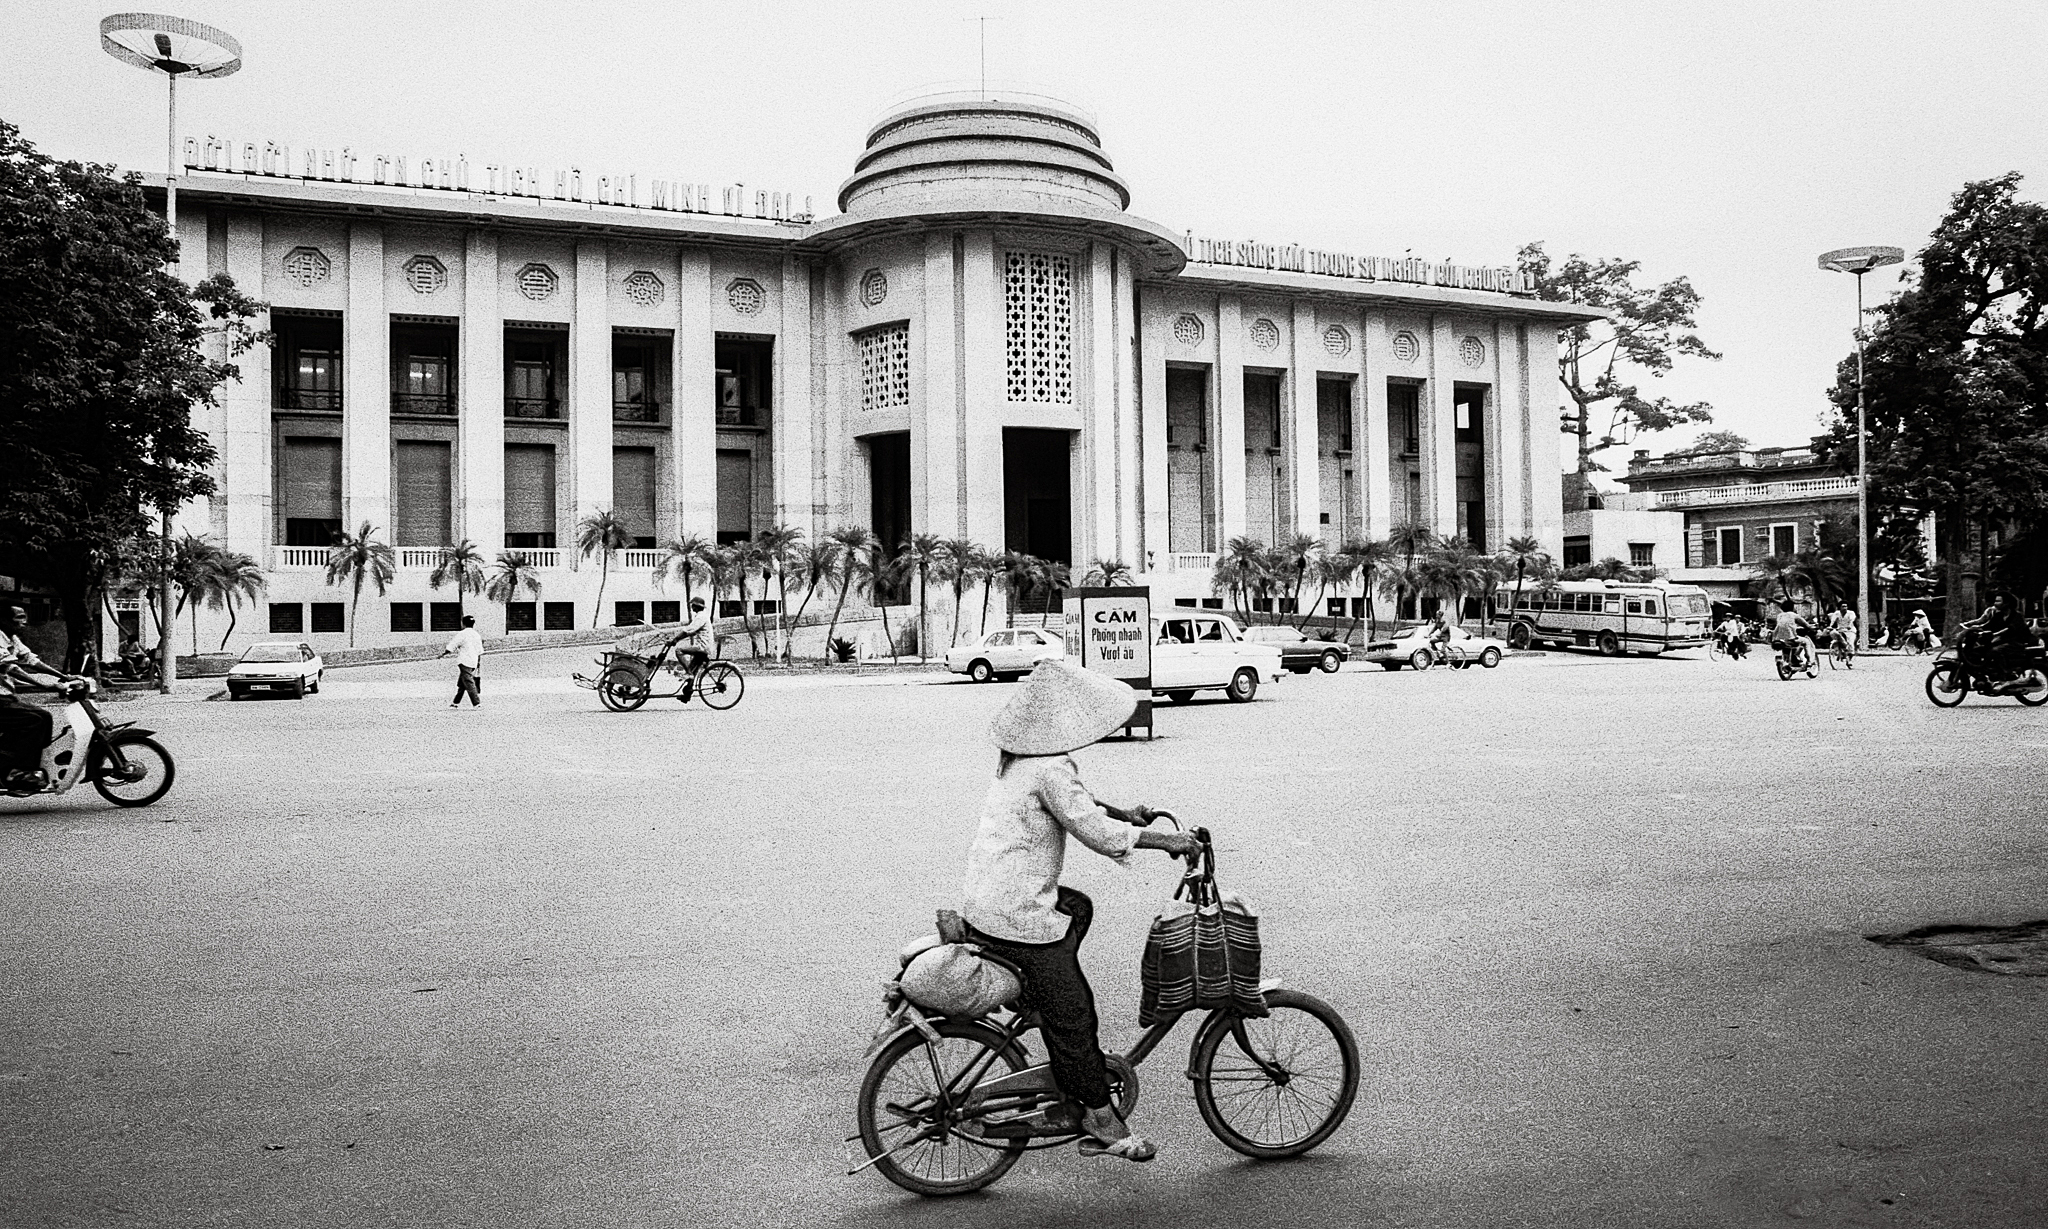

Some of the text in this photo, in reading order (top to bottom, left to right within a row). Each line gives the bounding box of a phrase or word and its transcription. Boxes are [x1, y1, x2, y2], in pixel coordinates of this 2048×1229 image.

[651, 179, 710, 213] MINH
[1308, 249, 1355, 278] TRONG
[1118, 627, 1143, 642] nhanh
